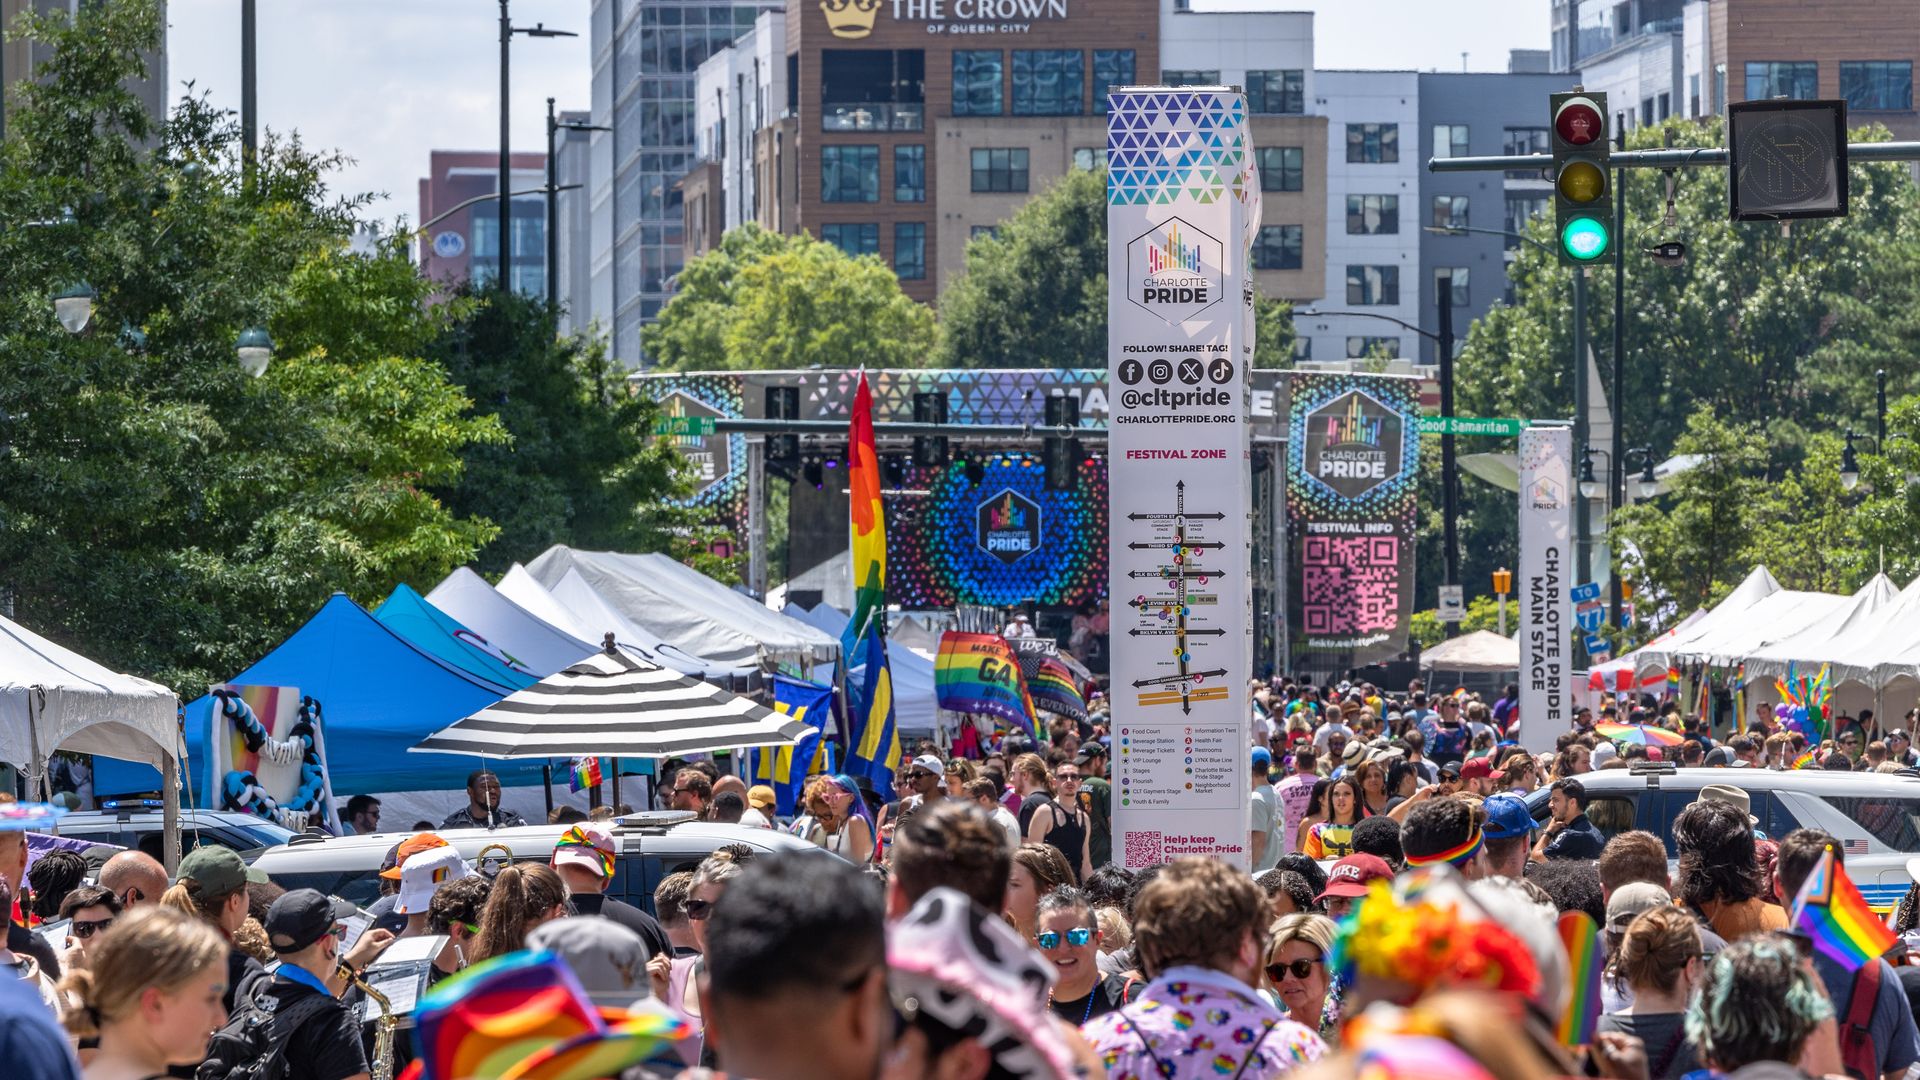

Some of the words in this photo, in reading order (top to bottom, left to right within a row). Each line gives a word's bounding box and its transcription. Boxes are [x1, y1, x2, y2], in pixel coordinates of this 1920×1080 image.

[890, 0, 945, 19] THE
[954, 0, 1068, 19] CROWN
[927, 24, 944, 34] OF
[950, 24, 995, 34] QUEEN
[1000, 24, 1030, 34] CITY
[1143, 278, 1208, 287] CHARLOTTE
[1143, 288, 1208, 304] PRIDE
[1123, 344, 1167, 353] FOLLOW!
[1168, 344, 1205, 353] SHARE!
[1206, 344, 1228, 352] TAG!
[1121, 386, 1231, 410] @cltpride
[1117, 415, 1236, 424] CHARLOTTEPRIDE.ORG
[1419, 419, 1446, 432] Good
[1451, 419, 1509, 433] Samaritan
[1126, 450, 1187, 459] FESTIVAL
[1191, 449, 1226, 459] ZONE
[1319, 451, 1386, 461] CHARLOTTE
[1318, 461, 1386, 479] PRIDE
[1533, 502, 1557, 510] PRIDE
[1307, 522, 1362, 533] FESTIVAL
[1364, 522, 1394, 533] INFO
[987, 538, 1031, 551] PRIDE
[1577, 588, 1593, 598] TO
[1531, 576, 1544, 625] MAIN
[1545, 546, 1559, 658] CHARLOTTE
[1579, 609, 1602, 629] 77
[970, 643, 1002, 656] MAKE
[1531, 631, 1545, 690] STAGE
[1547, 664, 1560, 720] PRIDE
[1164, 836, 1188, 845] Help
[1190, 835, 1215, 845] keep
[1164, 845, 1213, 854] Charlotte
[1215, 845, 1242, 853] Pride
